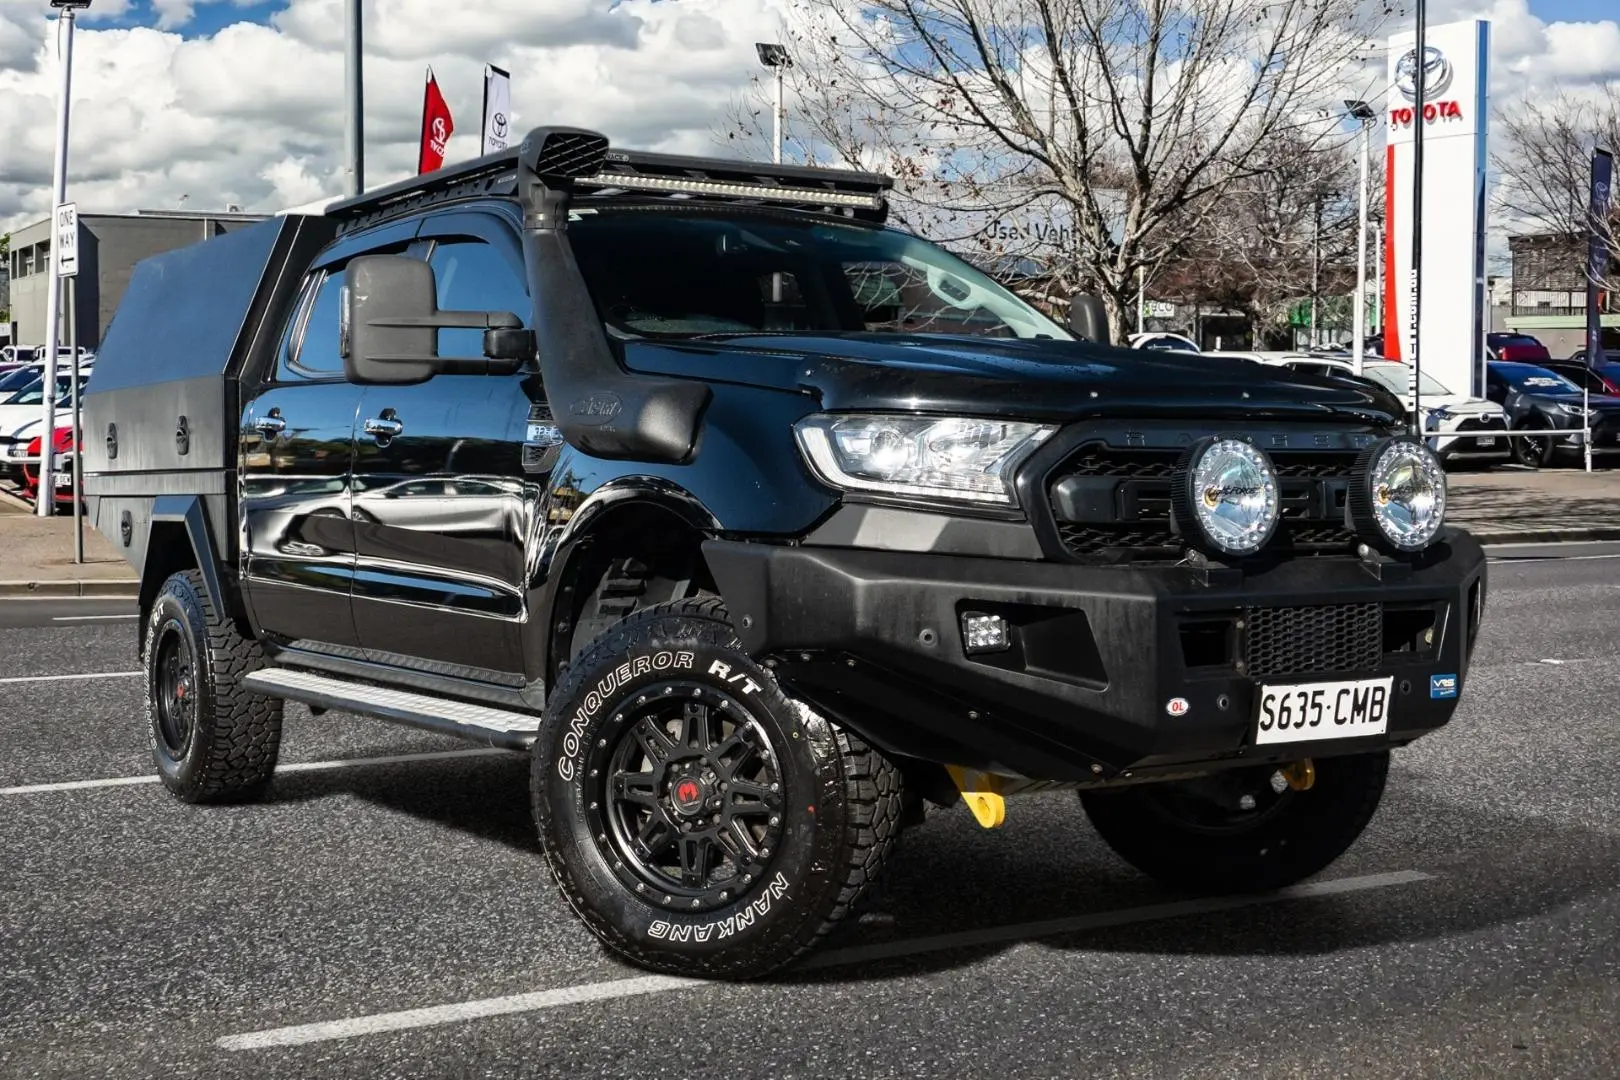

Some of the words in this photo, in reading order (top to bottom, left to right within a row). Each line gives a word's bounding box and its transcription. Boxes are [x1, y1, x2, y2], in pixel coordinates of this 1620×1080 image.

[1389, 100, 1462, 125] TOOTA
[60, 210, 73, 227] ONE
[60, 231, 75, 249] WAY
[558, 651, 695, 781] CONQUEROR
[707, 659, 763, 695] R/T
[648, 872, 790, 942] NANKANG
